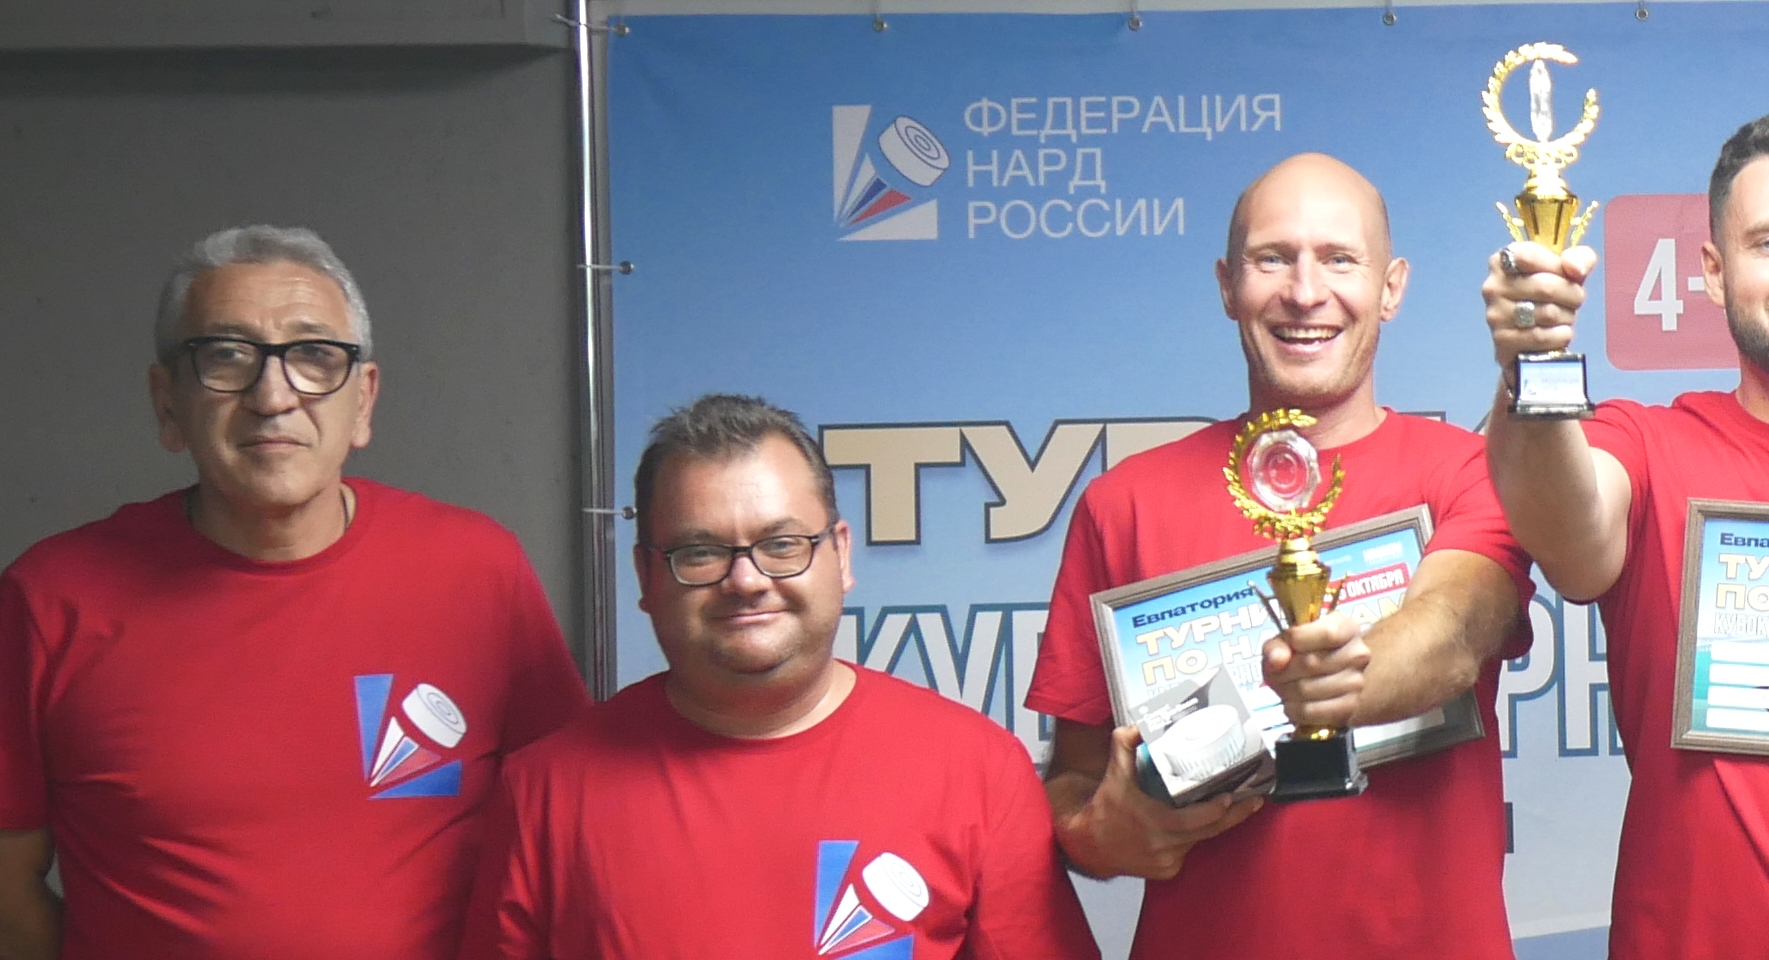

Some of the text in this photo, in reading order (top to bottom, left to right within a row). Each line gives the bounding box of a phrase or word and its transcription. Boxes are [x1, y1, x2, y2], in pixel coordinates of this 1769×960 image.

[964, 94, 1281, 141] ФЕДЕРАЦИЯ
[966, 147, 1106, 194] НАРД
[967, 197, 1185, 239] РОССИИ
[1132, 587, 1254, 629] Евпатория
[1141, 647, 1209, 687] ПО
